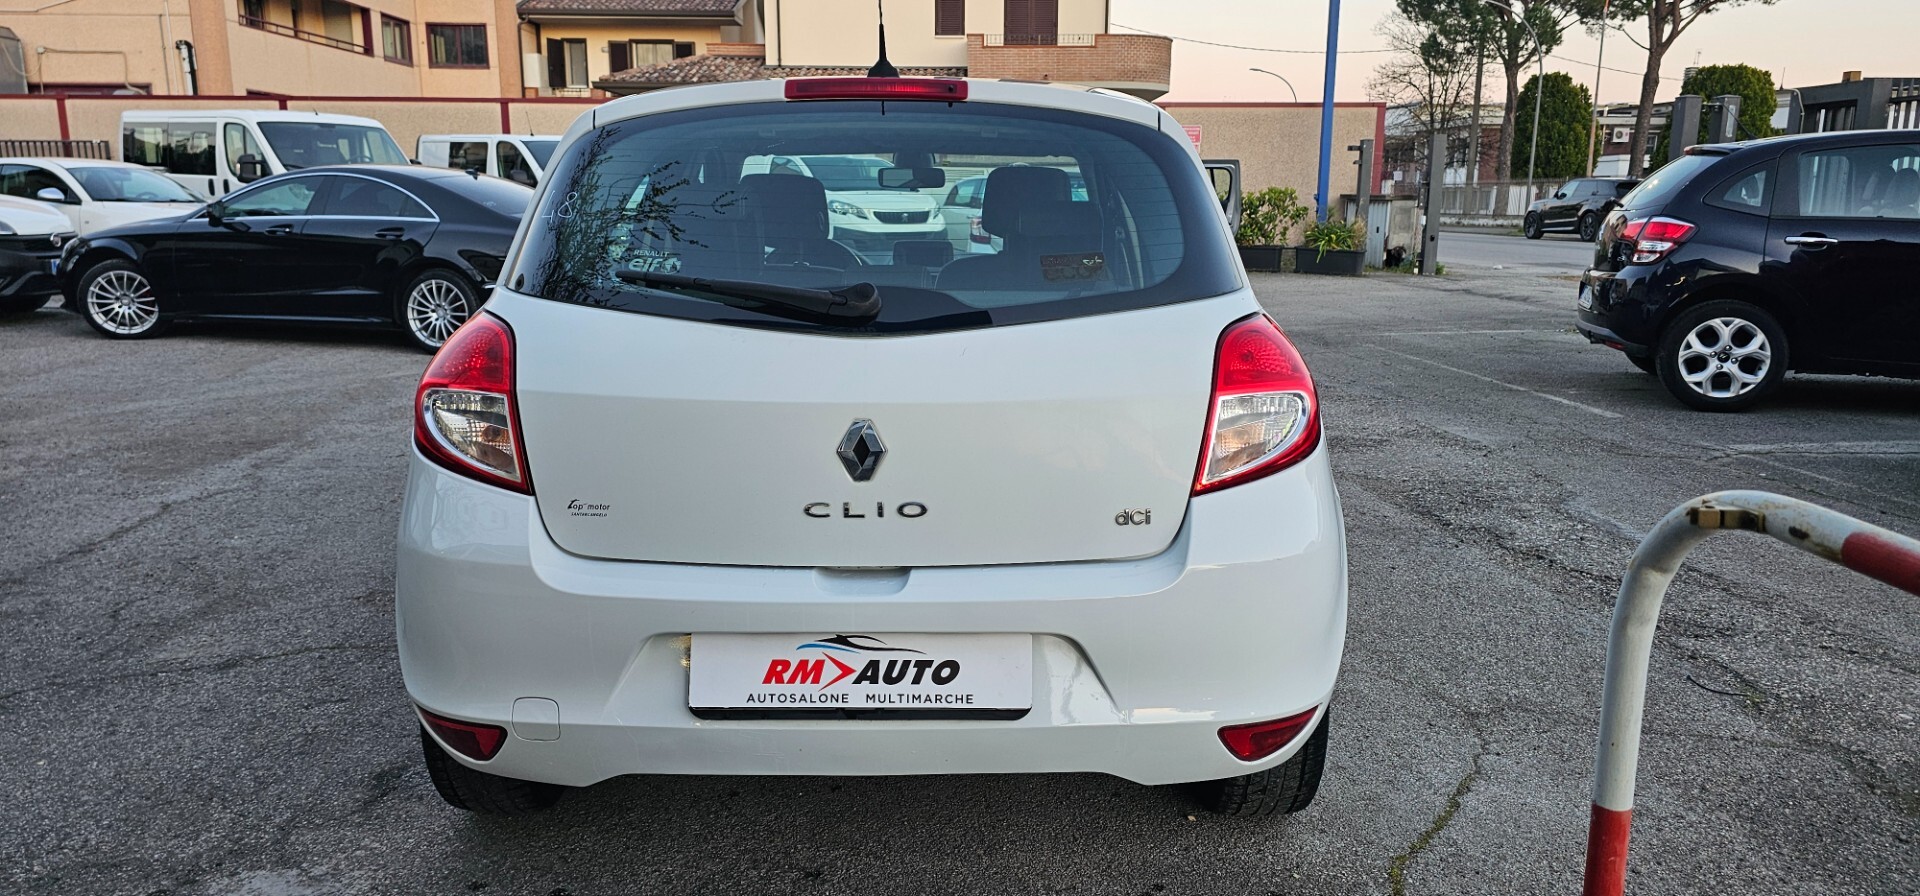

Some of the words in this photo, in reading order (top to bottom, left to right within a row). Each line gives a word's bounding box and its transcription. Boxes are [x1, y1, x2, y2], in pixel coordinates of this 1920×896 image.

[541, 190, 578, 223] 48
[633, 249, 670, 258] RENAULT
[629, 258, 663, 272] elf
[803, 501, 928, 519] CLIO
[1115, 507, 1151, 526] dCi
[761, 659, 826, 685] RM
[852, 659, 961, 685] AUTO
[746, 693, 850, 704] AUTOSALONE
[866, 693, 974, 704] MULTIMARCHE
